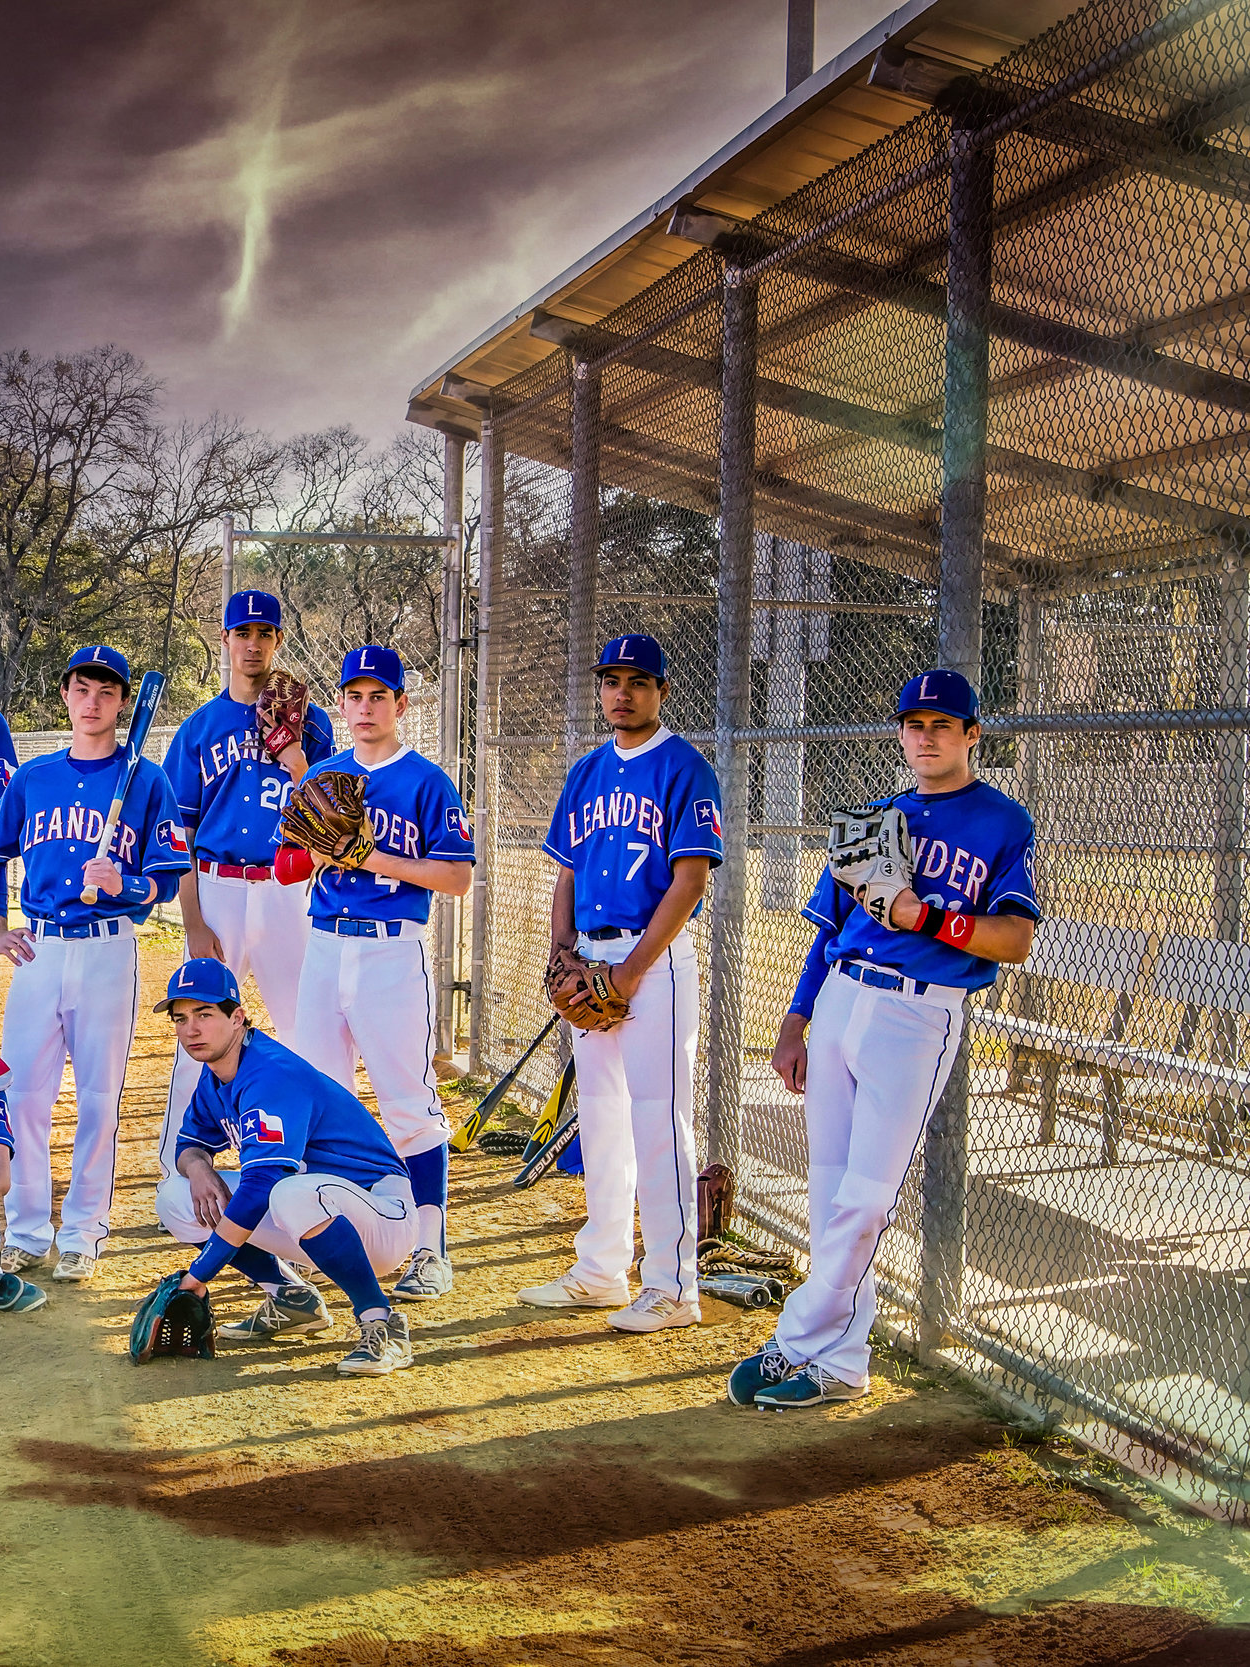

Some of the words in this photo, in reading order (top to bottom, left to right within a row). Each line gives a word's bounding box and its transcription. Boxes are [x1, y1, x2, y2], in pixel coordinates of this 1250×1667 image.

[248, 595, 262, 615] L
[92, 646, 108, 663] L
[359, 649, 375, 670] L
[618, 639, 635, 660] L
[918, 675, 938, 701] L
[568, 791, 665, 850] LEANDER
[625, 842, 650, 882] 7
[178, 965, 194, 988] L
